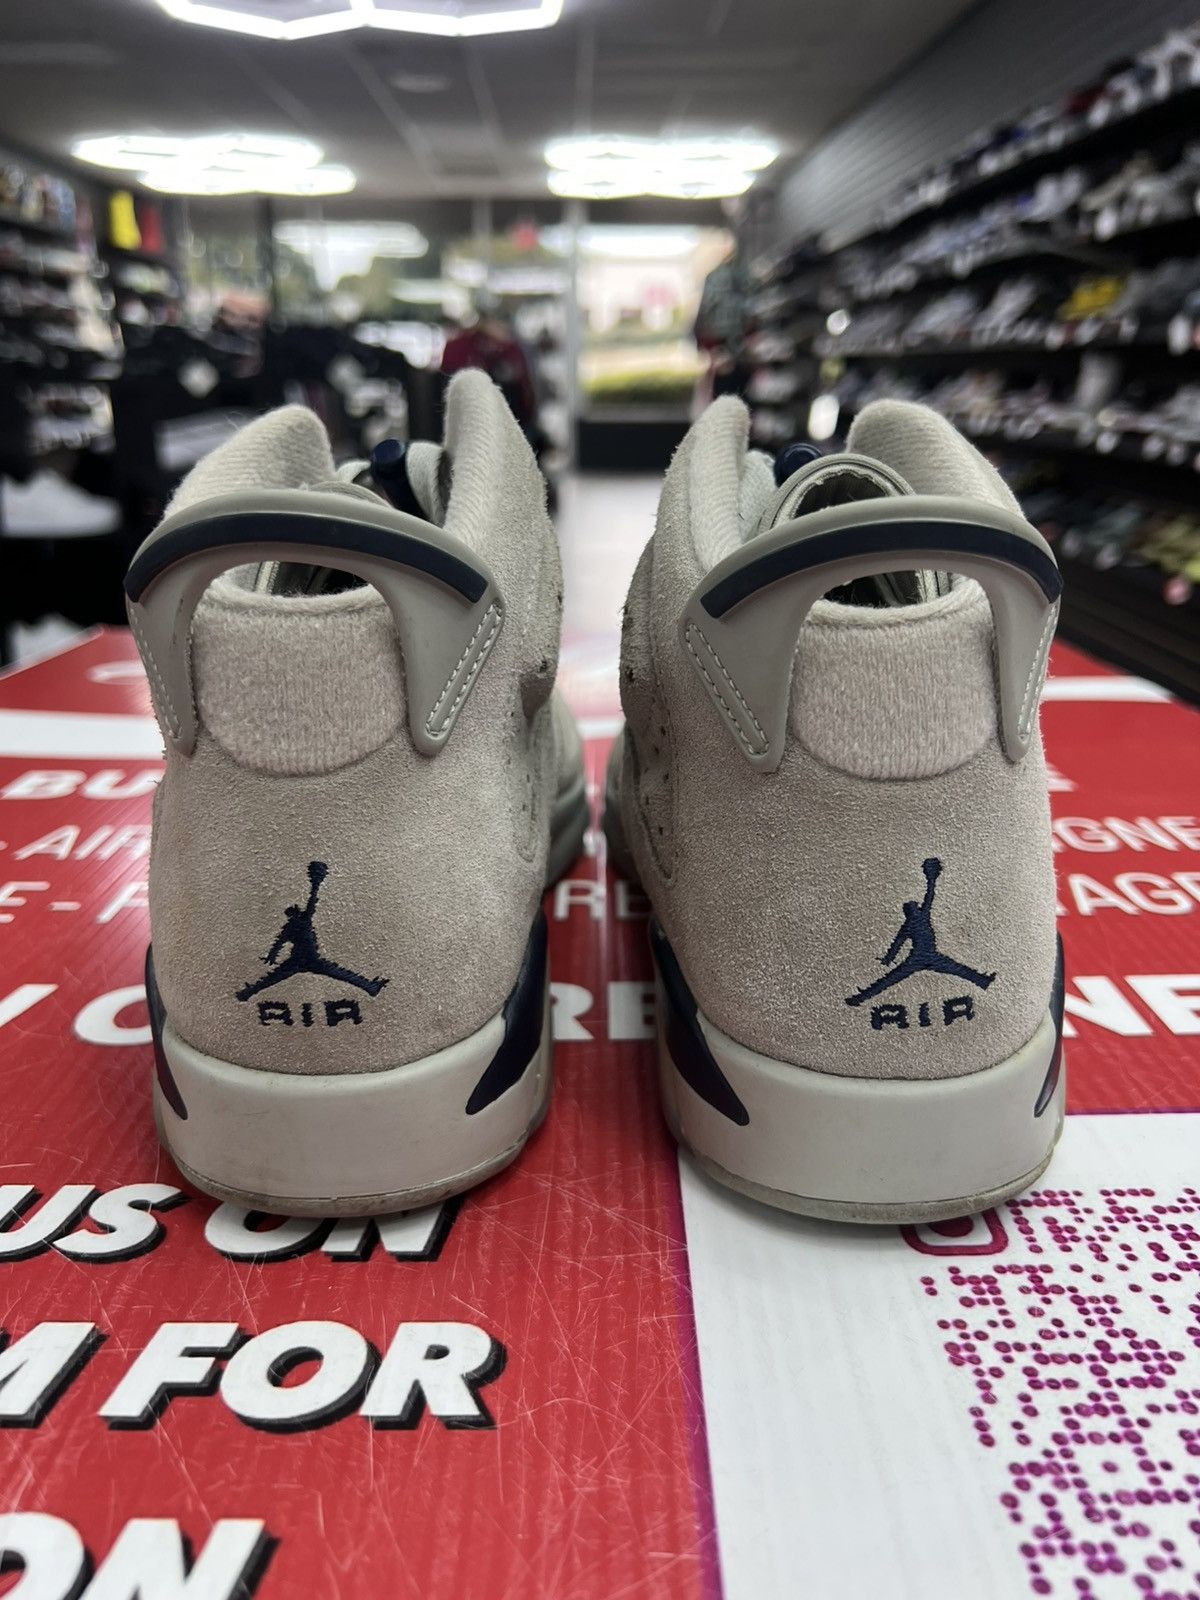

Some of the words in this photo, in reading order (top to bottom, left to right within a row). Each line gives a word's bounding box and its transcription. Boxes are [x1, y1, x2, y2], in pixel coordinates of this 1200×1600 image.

[1, 769, 165, 800] BU
[1052, 816, 1200, 852] GNE
[258, 999, 363, 1027] AIR
[870, 996, 975, 1030] AIR
[97, 1320, 503, 1430] FOR
